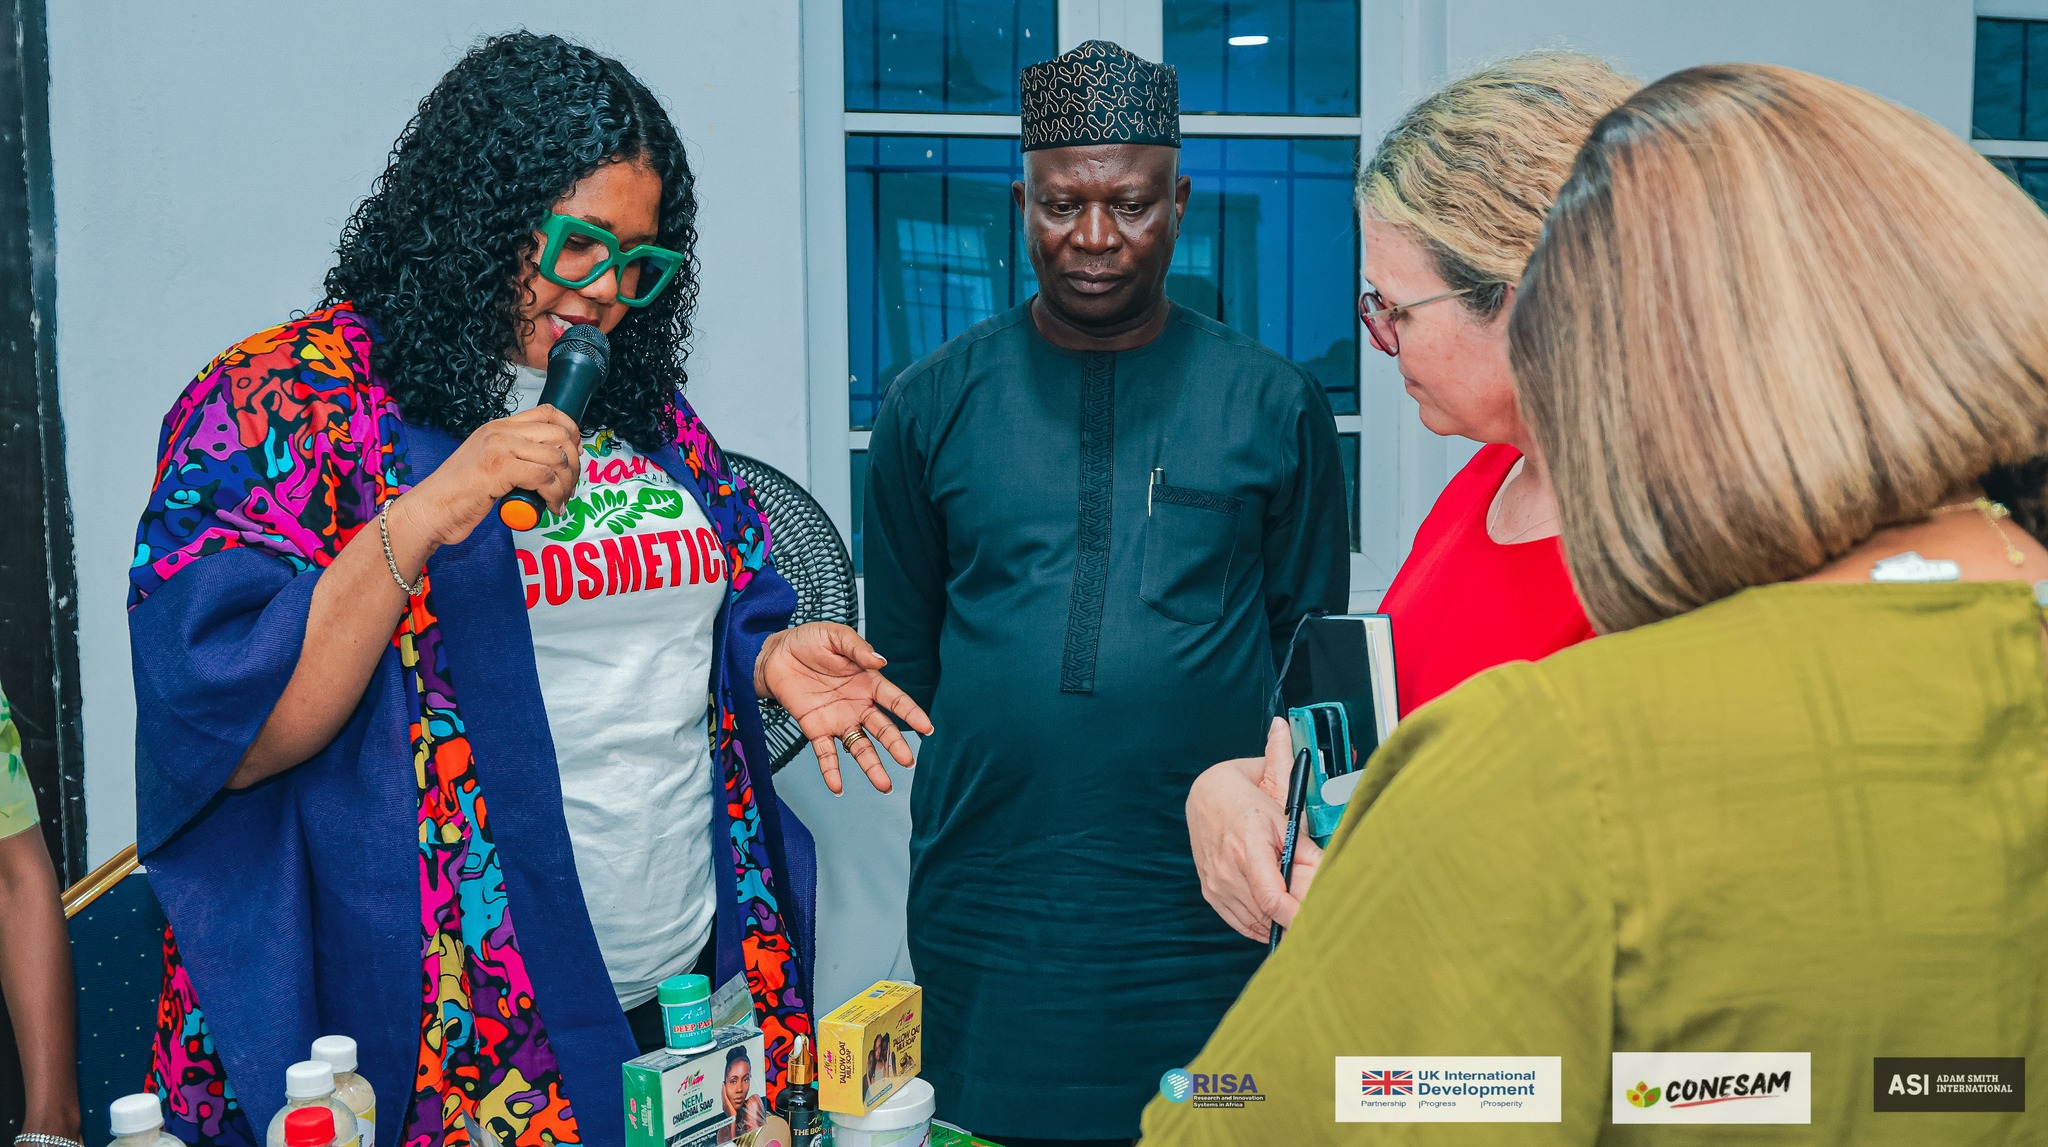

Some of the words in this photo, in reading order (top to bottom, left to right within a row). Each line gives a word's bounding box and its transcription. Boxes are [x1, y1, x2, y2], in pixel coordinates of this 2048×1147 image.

[673, 1023, 696, 1034] DEEP
[911, 1024, 921, 1036] OAT
[838, 1040, 846, 1056] OAT
[839, 1056, 847, 1085] TALLOW
[681, 1092, 703, 1111] NEEM
[672, 1105, 699, 1125] CHARCOAL
[699, 1098, 714, 1112] SOAP
[793, 1128, 809, 1136] THE
